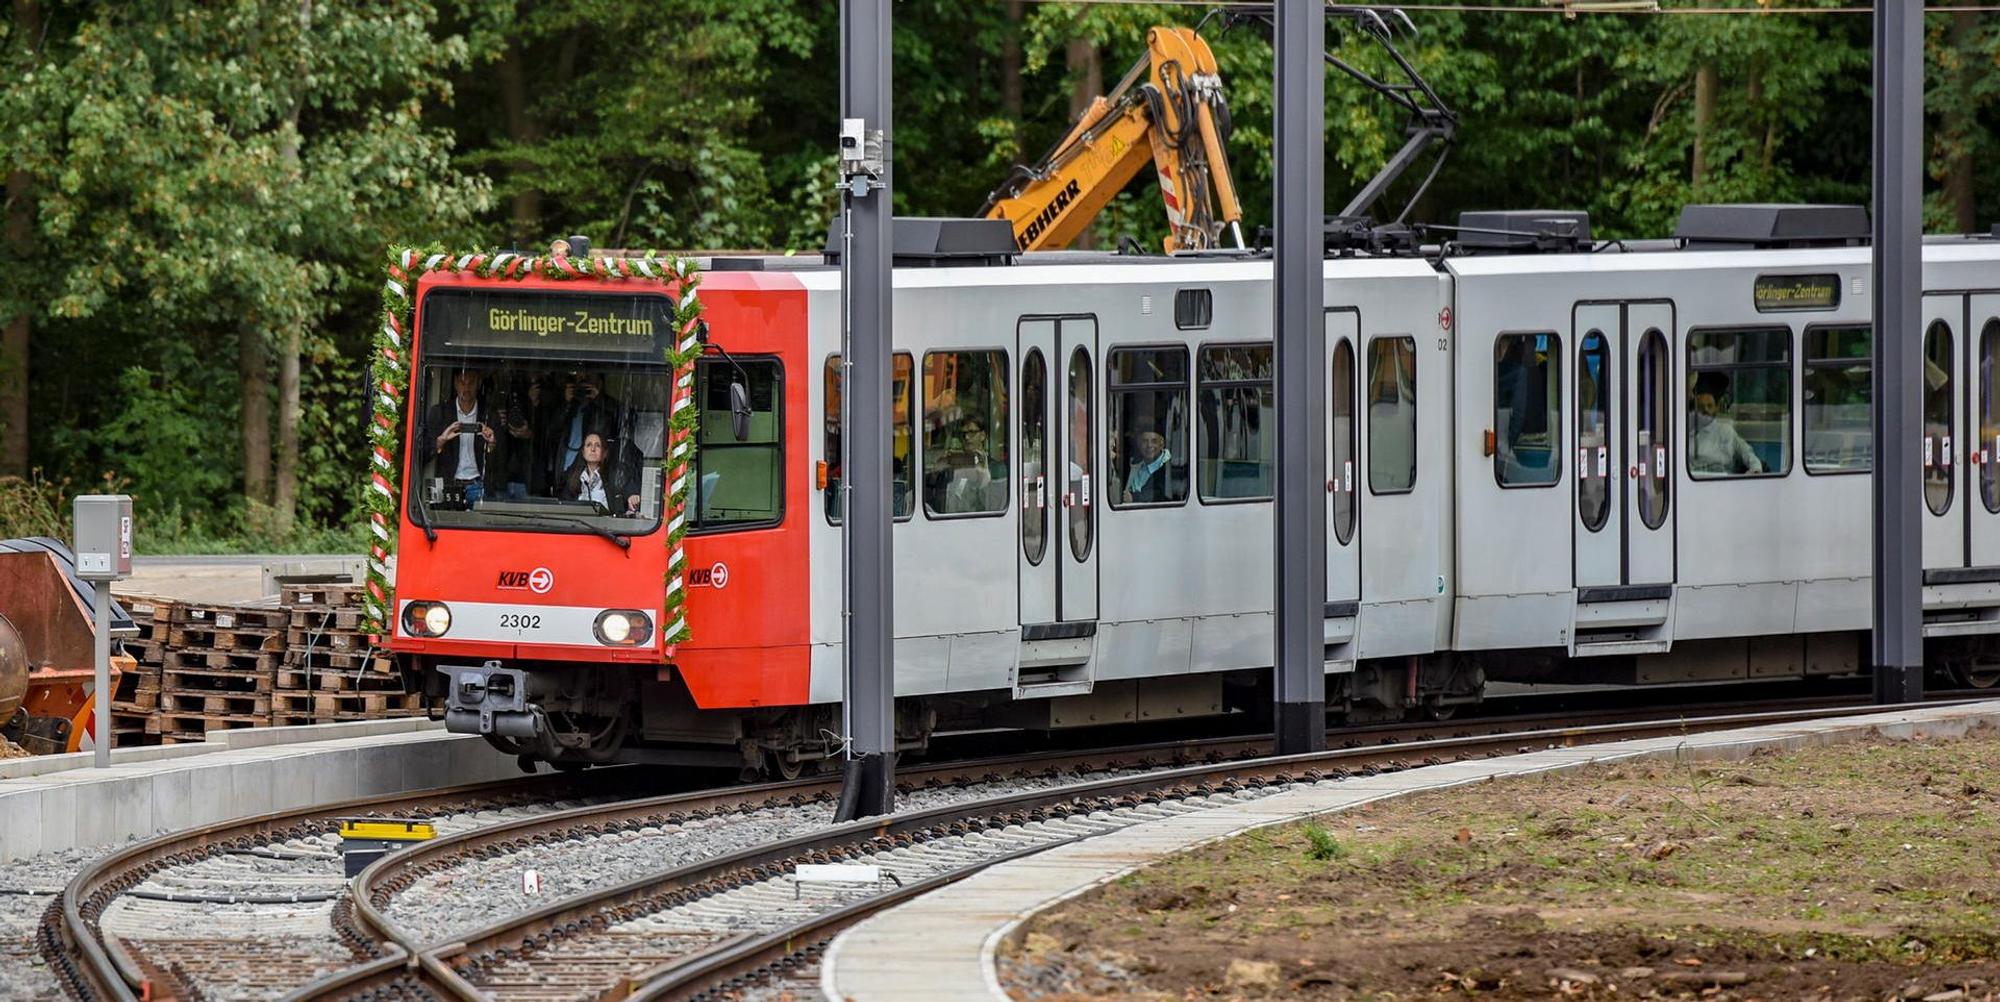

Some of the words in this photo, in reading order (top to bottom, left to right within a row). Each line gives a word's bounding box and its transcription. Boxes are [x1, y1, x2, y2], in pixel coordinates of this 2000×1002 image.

[1017, 178, 1081, 252] EBHERR
[489, 308, 653, 336] Görlinger-Zentrum
[498, 571, 530, 587] KVB
[689, 569, 711, 585] KVB
[500, 614, 541, 629] 2302
